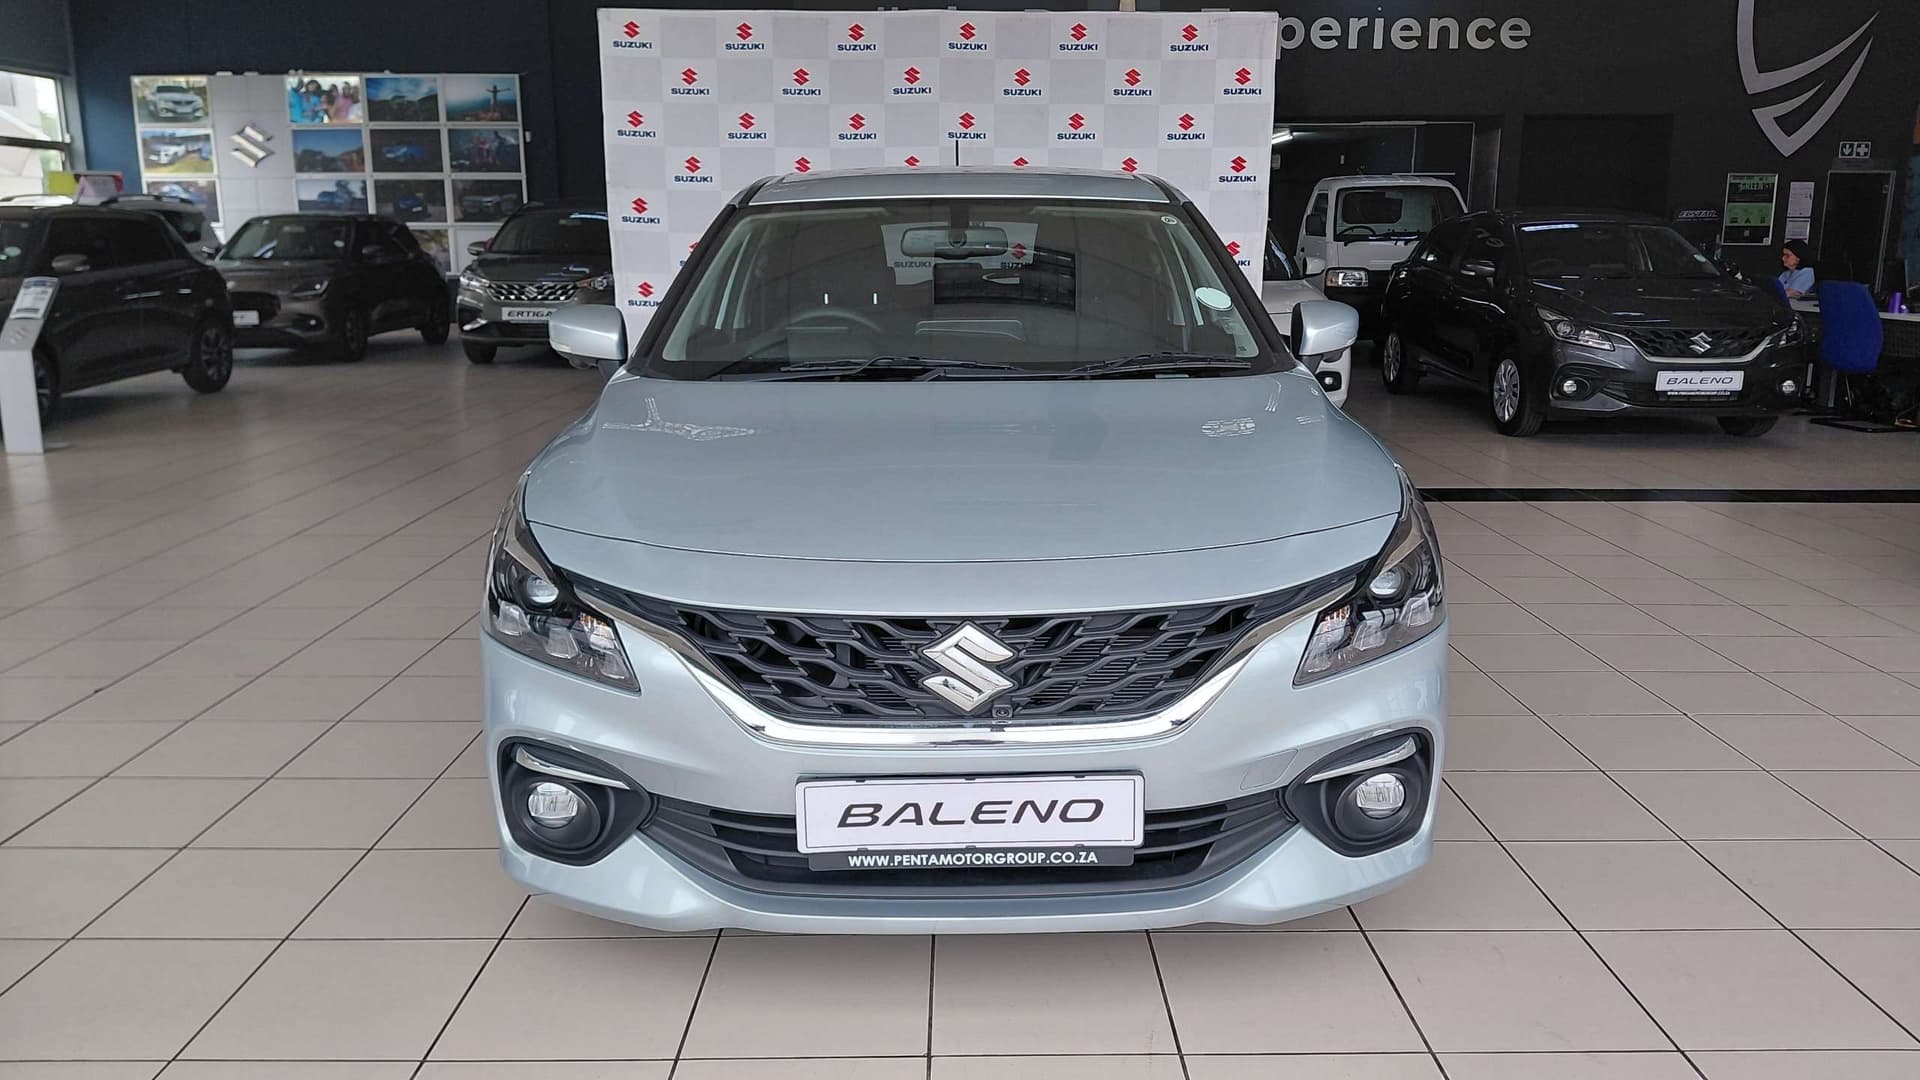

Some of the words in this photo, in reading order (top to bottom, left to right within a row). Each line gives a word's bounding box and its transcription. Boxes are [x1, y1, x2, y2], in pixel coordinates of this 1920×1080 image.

[612, 40, 653, 49] SUZUKI
[725, 42, 765, 51] SUZUKI
[837, 43, 877, 52] SUZUKI
[948, 42, 988, 51] SUZUKI
[1058, 43, 1099, 51] SUZUKI
[1170, 44, 1209, 52] SUZUKI
[670, 87, 710, 96] SUZUKI
[781, 88, 822, 96] SUZUKI
[892, 87, 932, 95] SUZUKI
[1003, 88, 1042, 97] SUZUKI
[1113, 88, 1152, 97] SUZUKI
[1223, 87, 1262, 96] SUZUKI
[617, 129, 656, 138] SUZUKI
[727, 132, 767, 140] SUZUKI
[838, 132, 877, 141] SUZUKI
[947, 131, 987, 140] SUZUKI
[1056, 132, 1096, 140] SUZUKI
[1166, 132, 1206, 141] SUZUKI
[674, 175, 713, 183] SUZUKI
[1218, 175, 1257, 183] SUZUKI
[621, 215, 661, 225] SUZUKI
[1666, 376, 1734, 385] BALENO
[837, 798, 1105, 829] BALENO
[847, 852, 1099, 869] WWW.PENTAMOTORGROUP.CO.ZA
